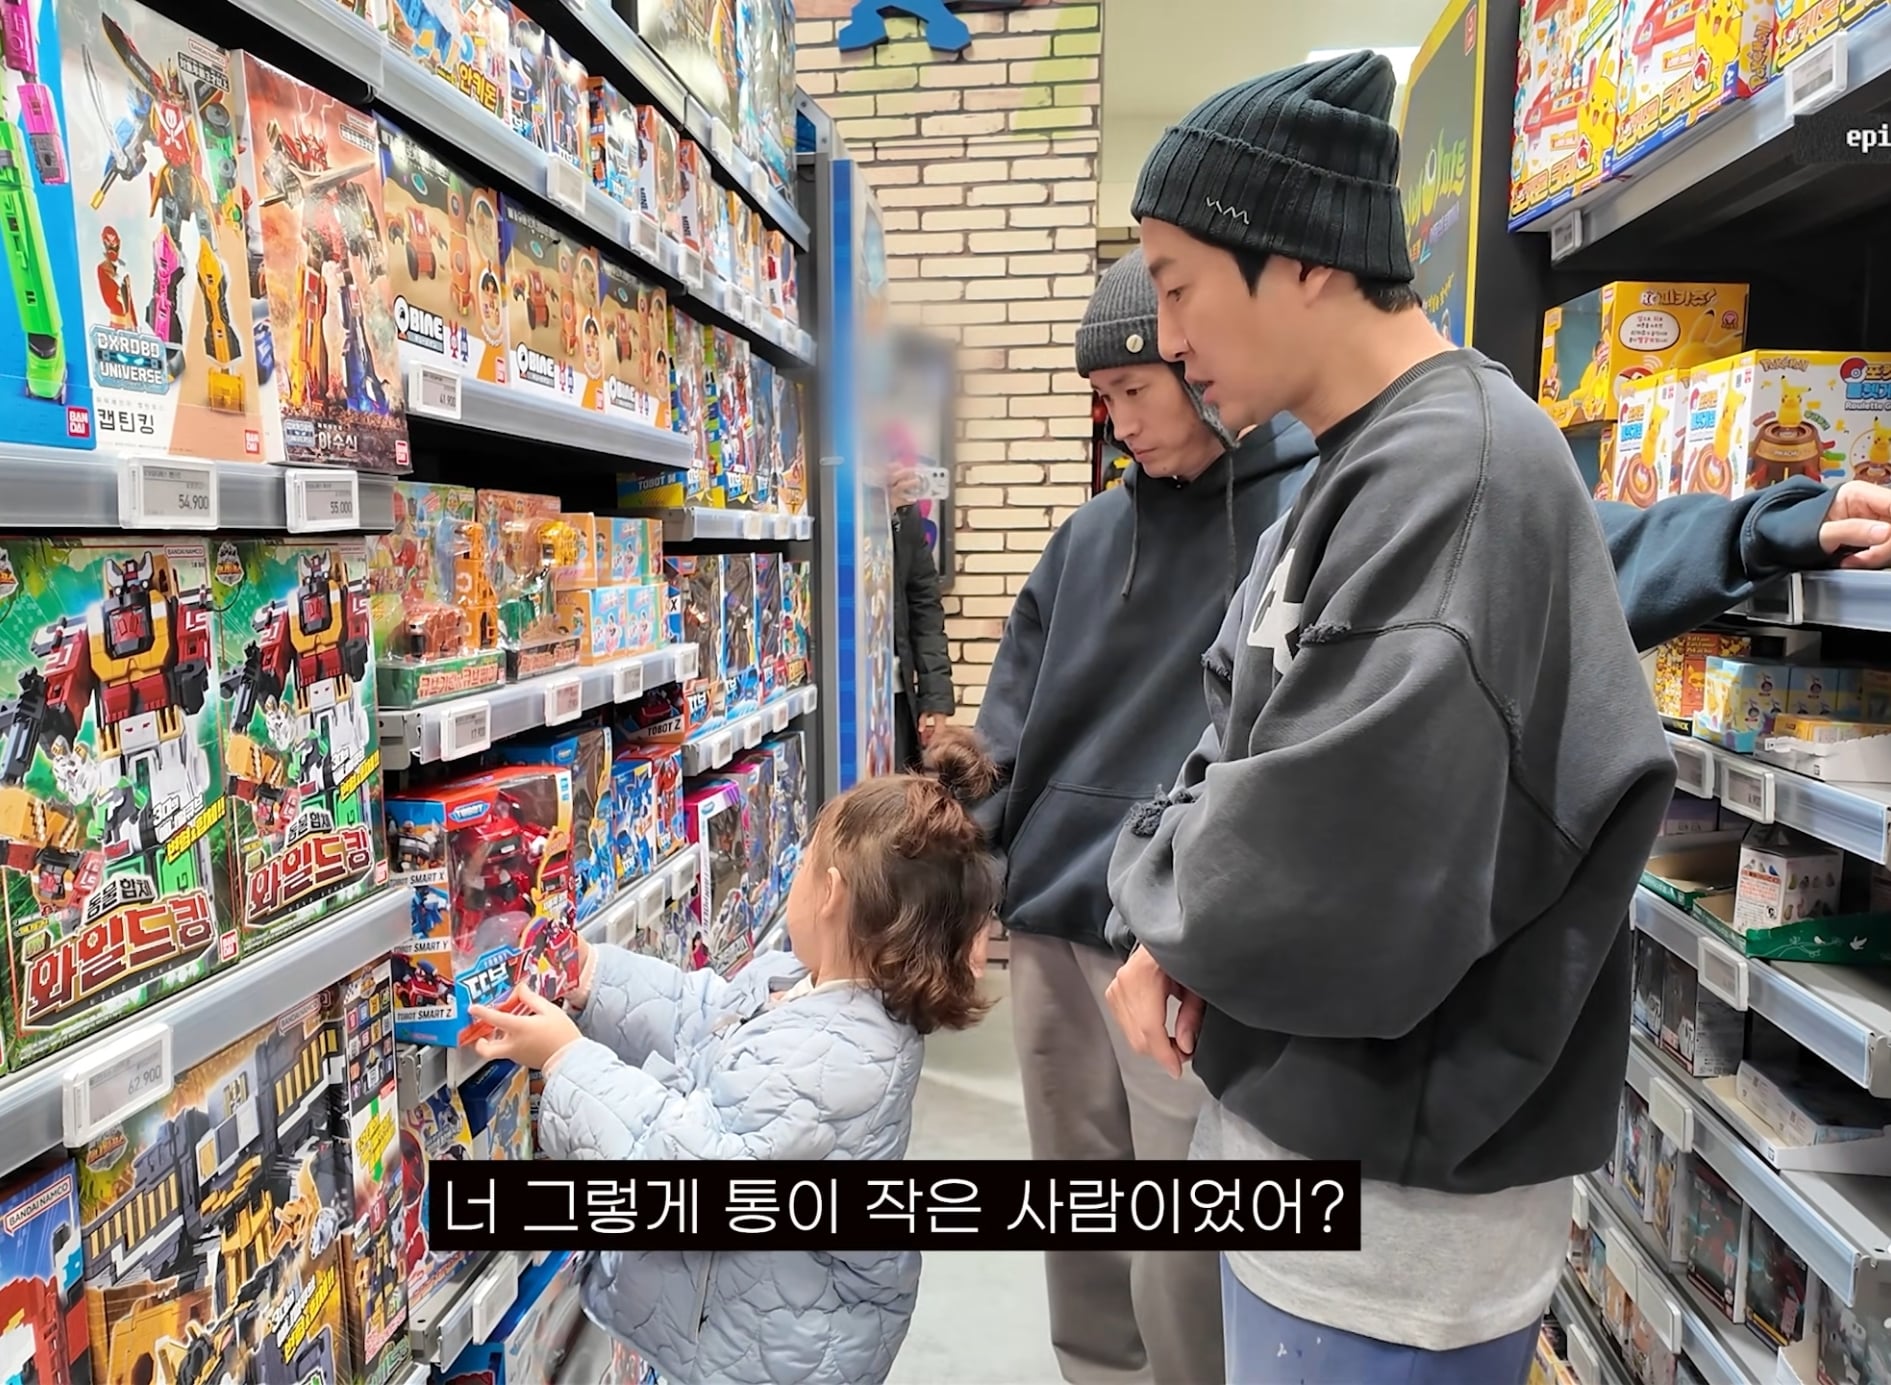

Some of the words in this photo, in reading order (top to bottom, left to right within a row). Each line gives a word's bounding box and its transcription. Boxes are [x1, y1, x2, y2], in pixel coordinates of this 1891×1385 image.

[101, 362, 163, 385] UNIVERSE
[97, 408, 154, 435] 캡틴킹
[648, 722, 673, 737] TOBOT
[250, 829, 370, 915] 와일드킹
[410, 873, 437, 885] SMART
[27, 894, 212, 1018] 와일드킹
[414, 942, 440, 952] SMART
[418, 1009, 444, 1019] SMART
[9, 1200, 40, 1226] BANDAI
[40, 1183, 68, 1206] NAMCO
